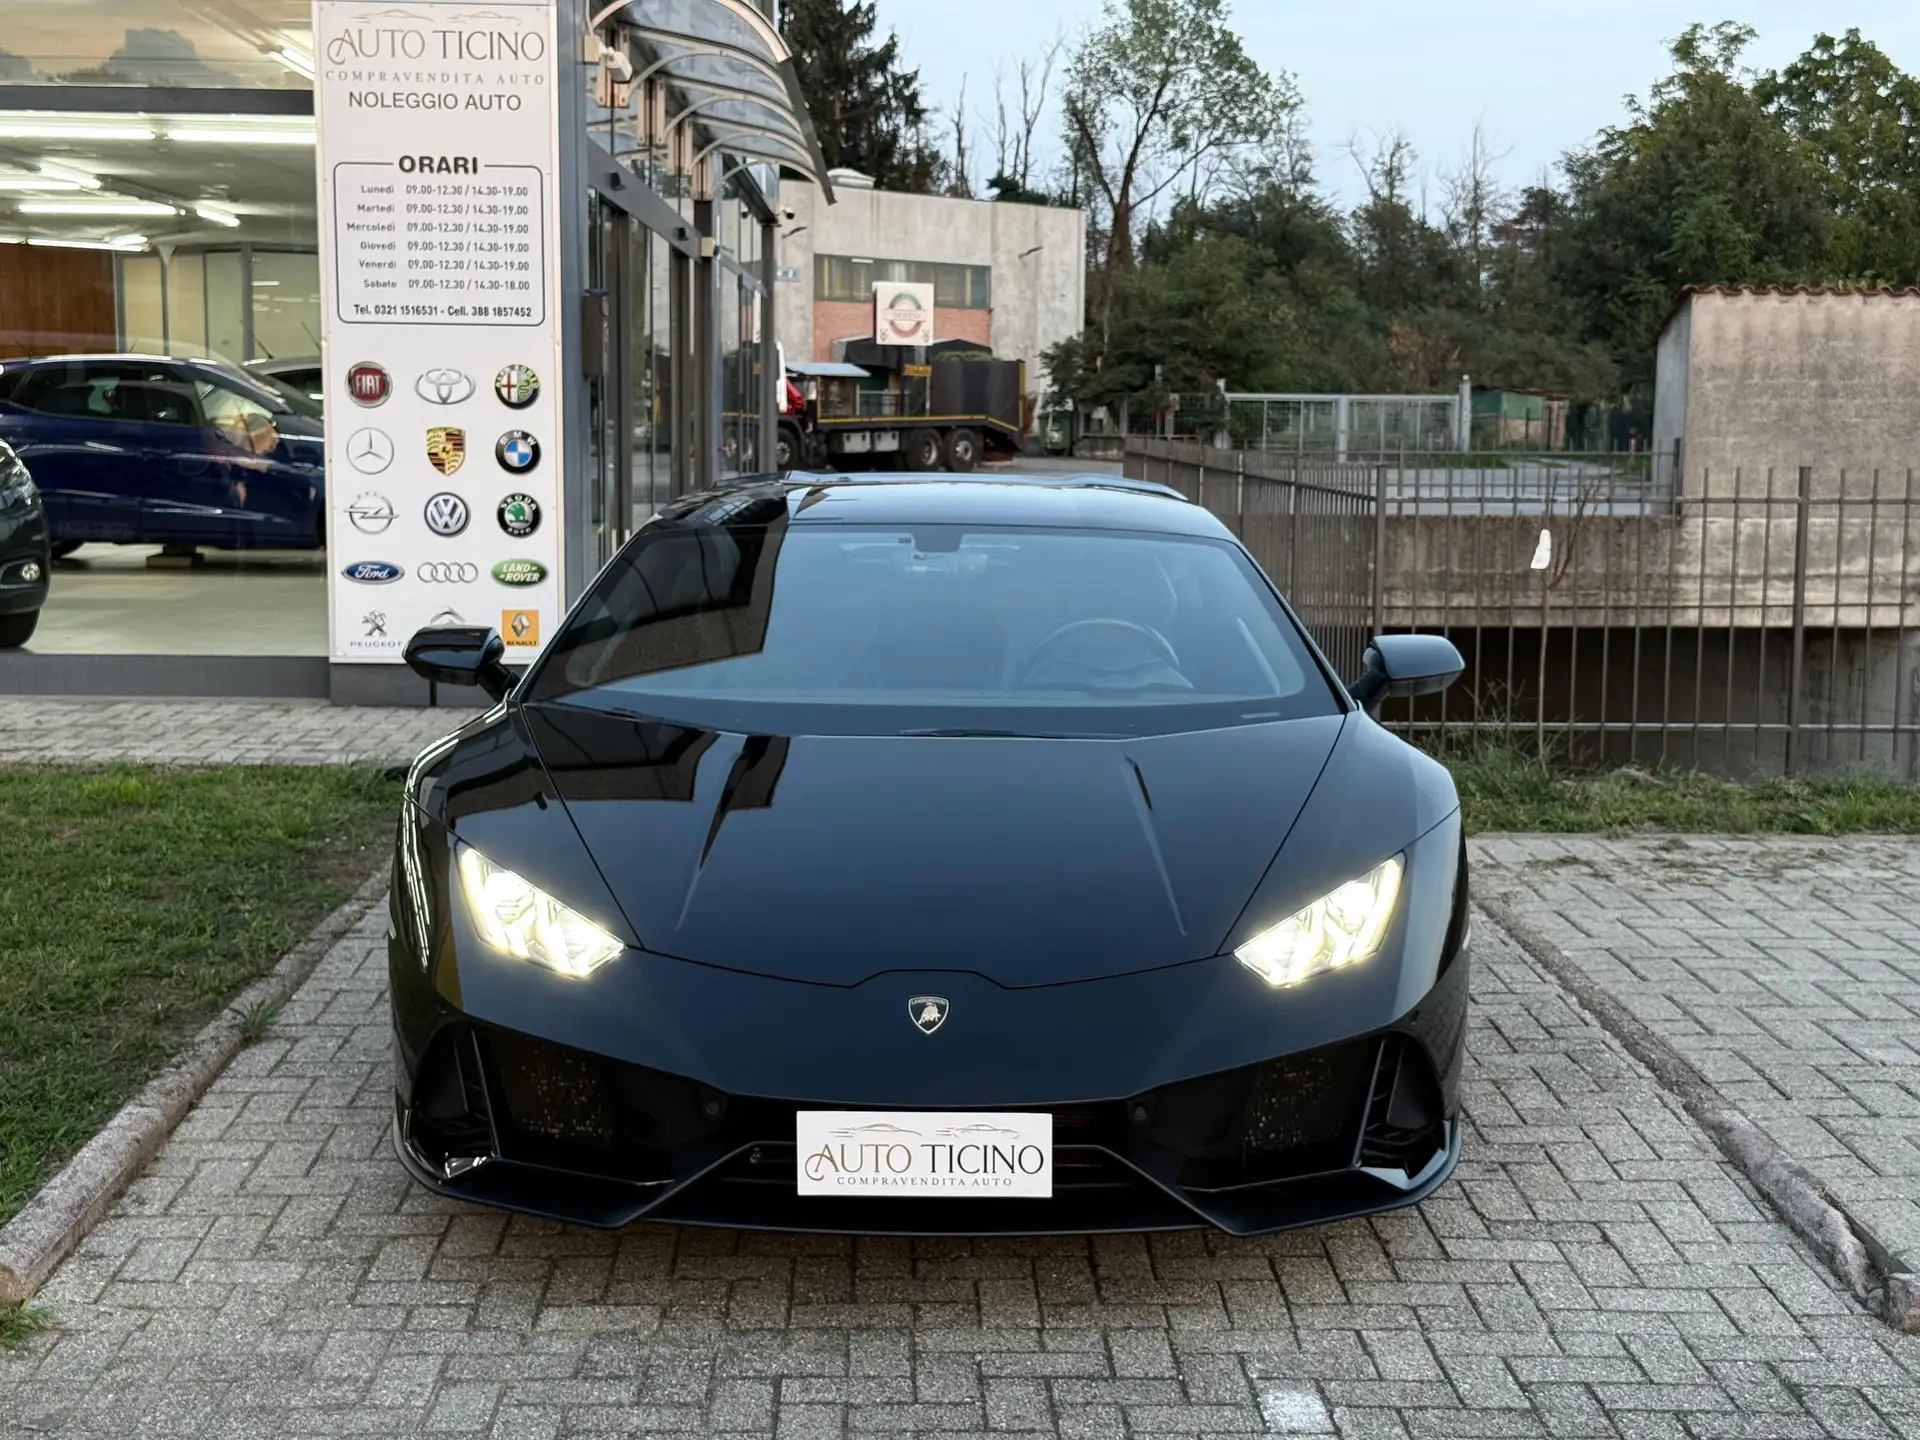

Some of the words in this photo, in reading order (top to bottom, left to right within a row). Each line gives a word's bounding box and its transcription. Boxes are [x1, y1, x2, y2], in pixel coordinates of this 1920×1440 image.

[327, 28, 426, 65] AUTO
[433, 29, 545, 62] TICINO
[325, 70, 484, 85] COMPRAVENDITA
[496, 73, 545, 86] AUTO
[349, 91, 458, 111] NOLEGGIO
[464, 93, 522, 111] AUTO
[398, 155, 479, 175] ORARI
[363, 279, 397, 289] Sabato
[353, 304, 372, 315] Tel.
[447, 305, 469, 317] Cell.
[355, 374, 380, 395] FIAT
[499, 431, 536, 447] BMW
[355, 564, 390, 579] Ford
[350, 640, 404, 649] PEUGEOT
[804, 1143, 912, 1181] AUTO
[920, 1144, 1044, 1175] TICINO
[837, 1176, 966, 1186] COMPRAVENDITA
[972, 1177, 1013, 1186] AUTO
